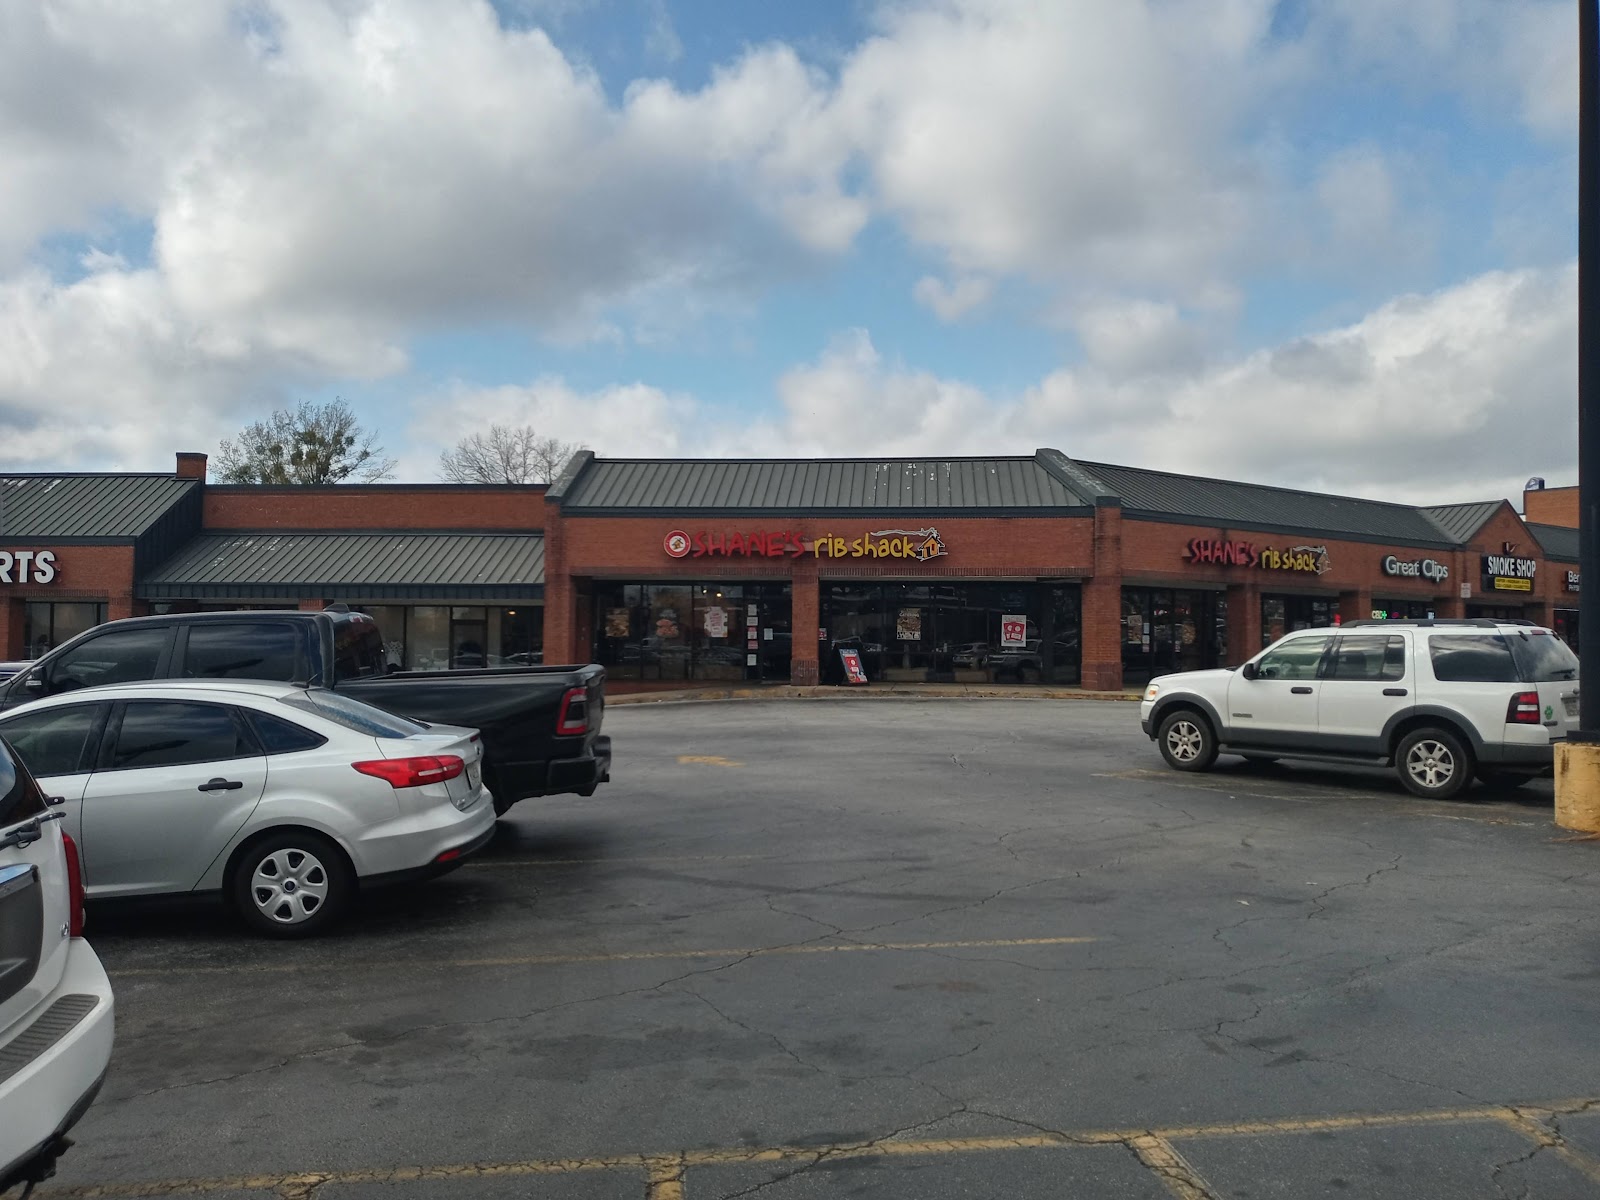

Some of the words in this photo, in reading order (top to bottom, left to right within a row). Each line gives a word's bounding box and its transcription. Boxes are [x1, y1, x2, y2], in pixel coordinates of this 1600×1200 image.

[693, 531, 806, 557] SHANE'S
[852, 533, 917, 558] shack
[1191, 540, 1258, 567] SHANE'S
[1283, 548, 1316, 572] shack
[0, 551, 55, 584] RTS
[1386, 556, 1420, 575] Great
[1422, 559, 1449, 582] Clips
[1488, 556, 1515, 575] SMOKE
[1516, 559, 1536, 577] SHOP
